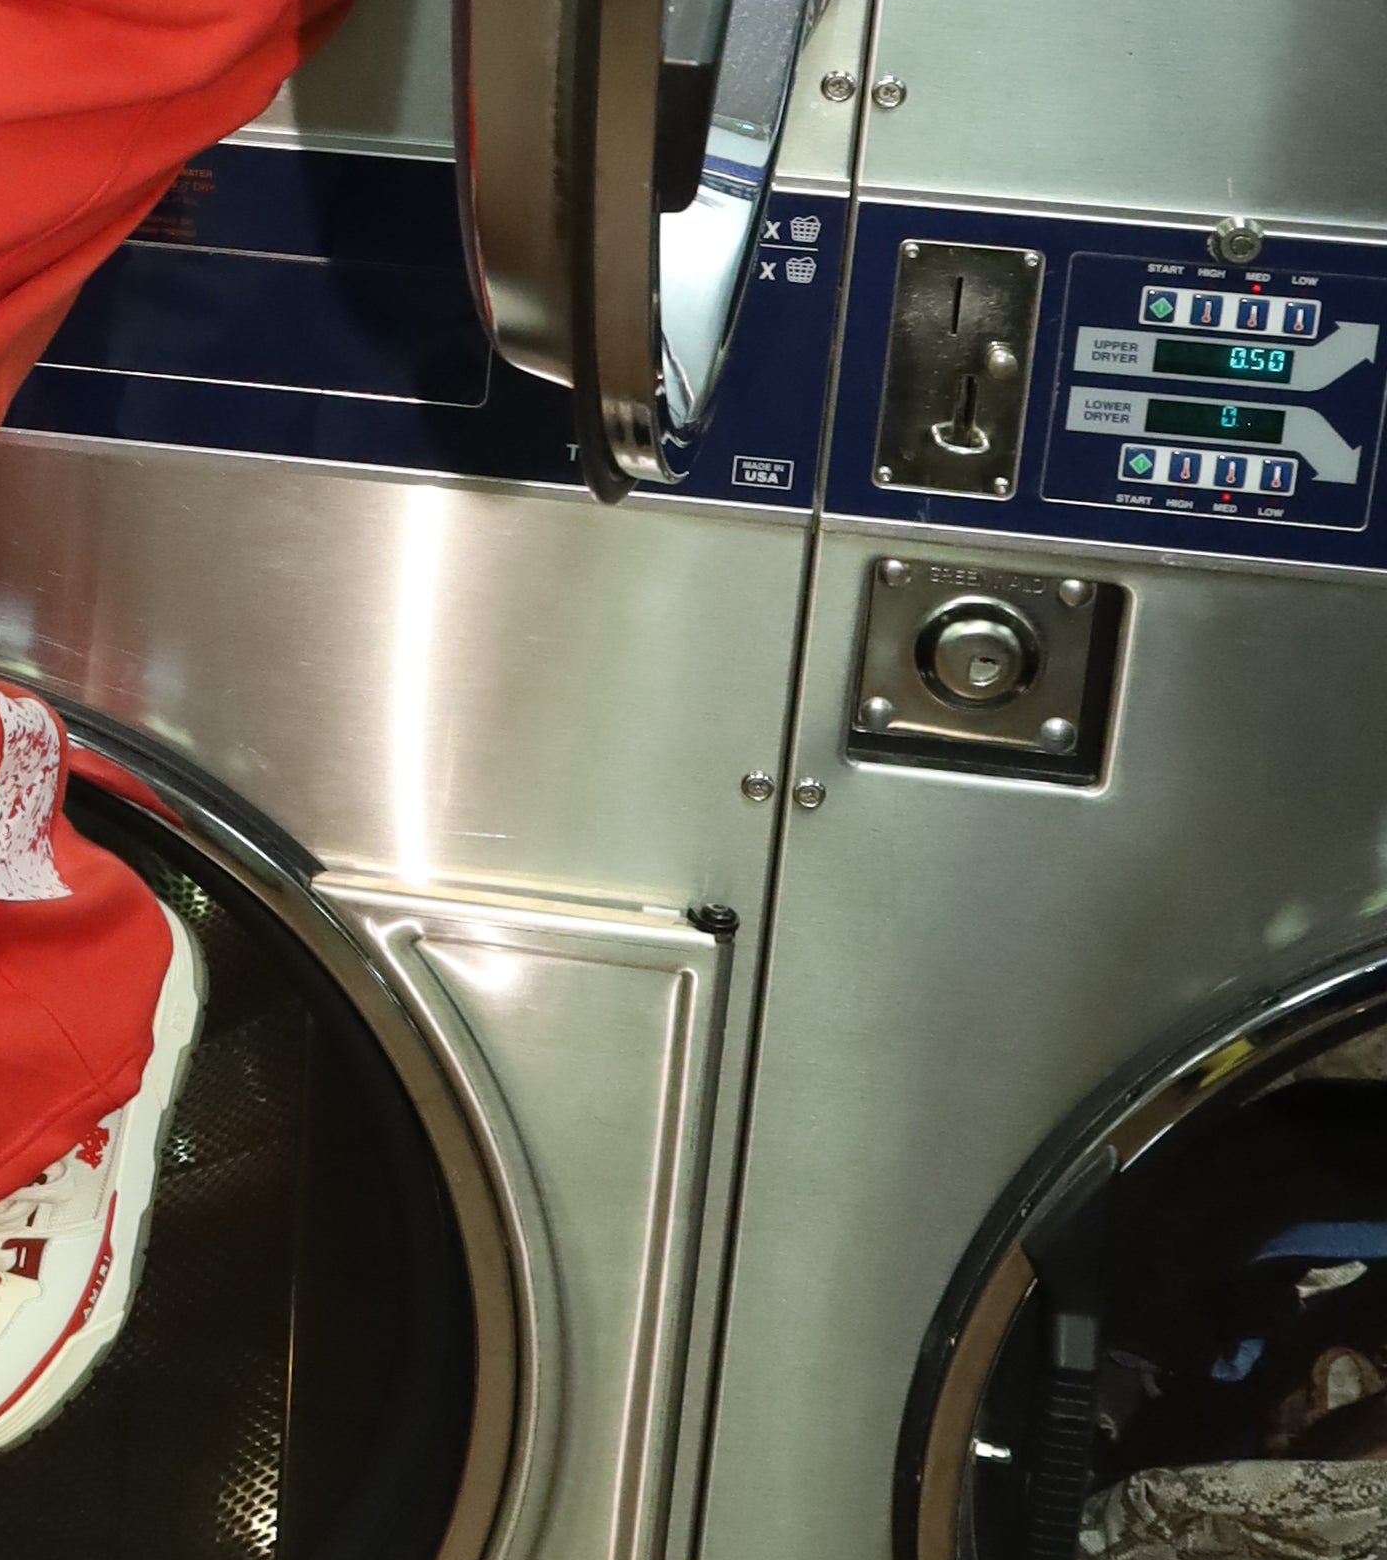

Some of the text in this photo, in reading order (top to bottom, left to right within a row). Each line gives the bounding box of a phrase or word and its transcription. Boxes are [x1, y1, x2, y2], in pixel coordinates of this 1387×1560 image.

[1148, 263, 1319, 287] START HIGH MED LOW
[1094, 339, 1139, 353] UPPER
[1091, 350, 1138, 364] DRYER
[1085, 400, 1131, 413] LOWER
[1084, 411, 1130, 424] DRYER
[742, 461, 772, 471] MADE
[744, 470, 779, 484] USA
[1115, 493, 1284, 518] START HIGH MED LOW
[83, 1255, 111, 1319] AMIRI
